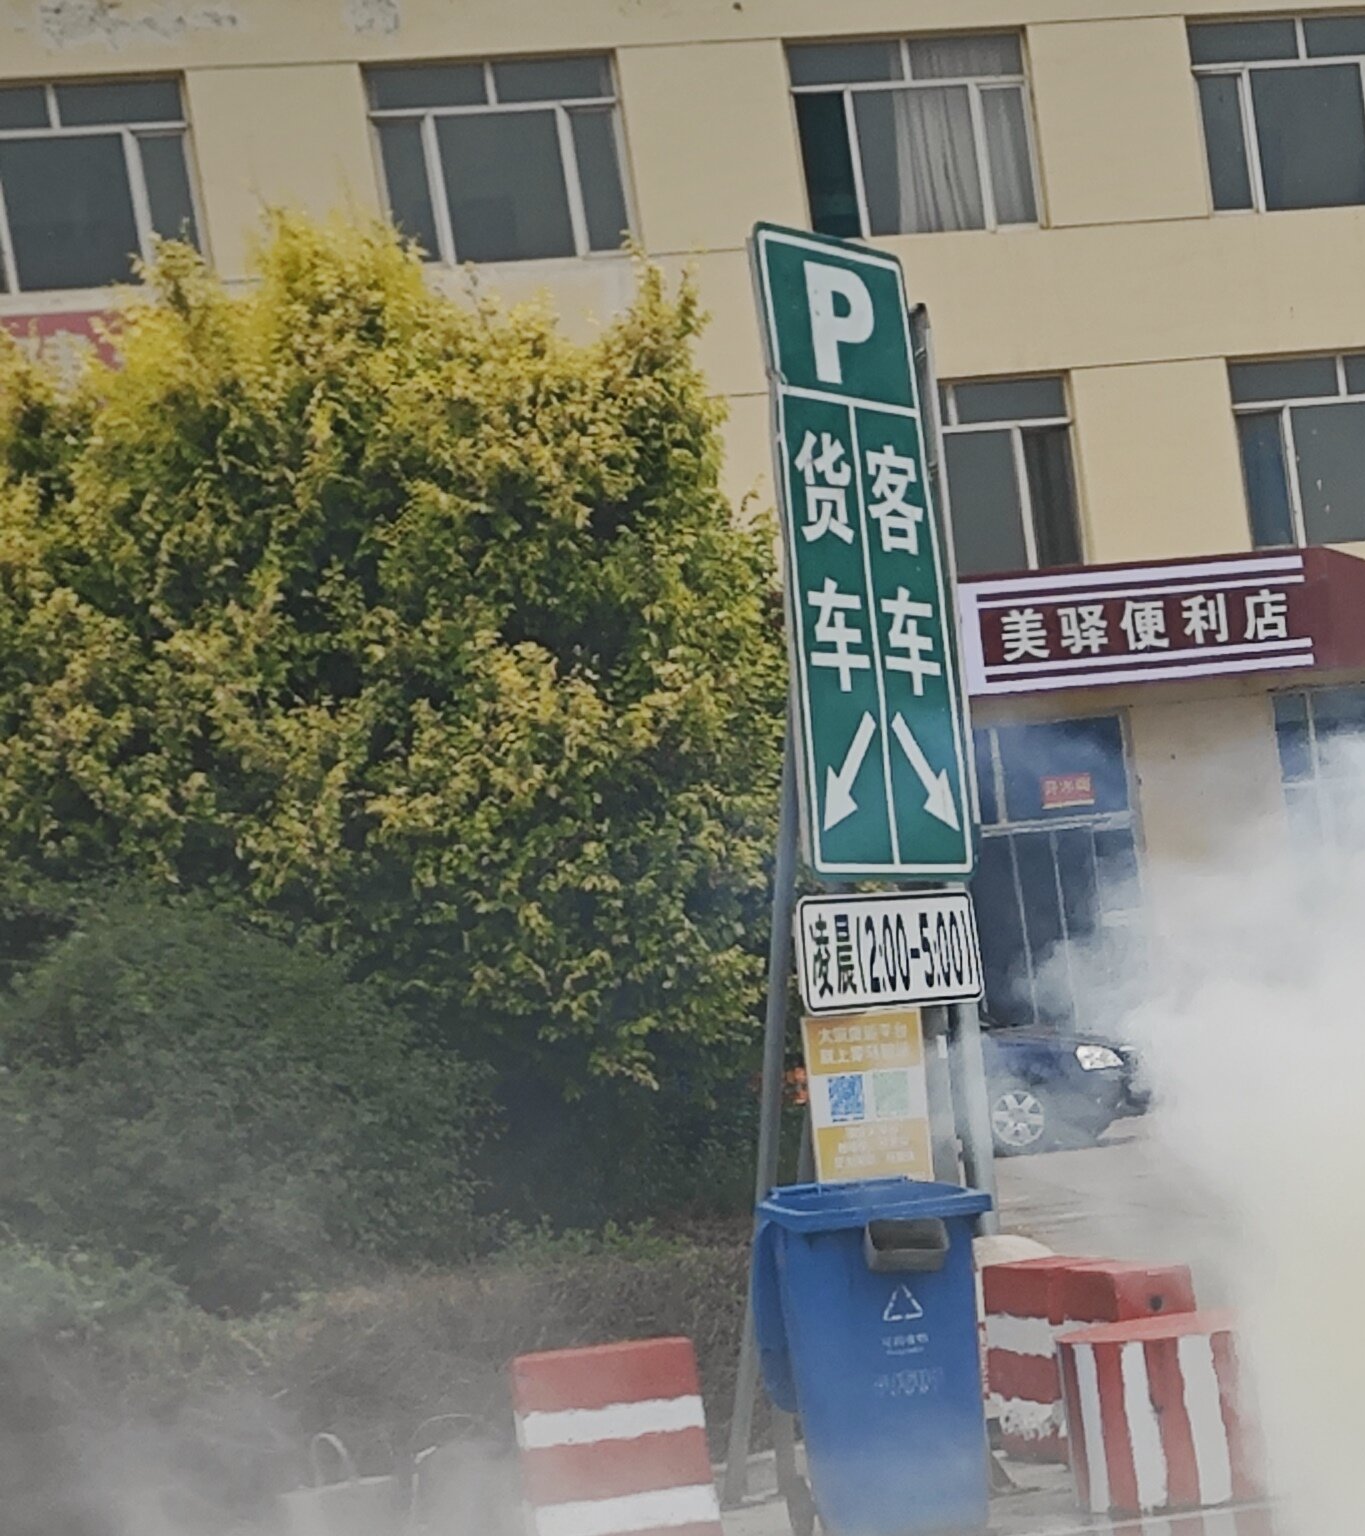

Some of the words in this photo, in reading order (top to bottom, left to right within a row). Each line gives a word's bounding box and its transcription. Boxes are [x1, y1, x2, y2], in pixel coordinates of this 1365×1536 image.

[804, 260, 875, 384] P
[794, 429, 871, 693] 货车
[866, 444, 942, 697] 客车
[1001, 588, 1289, 662] 美驿便利店
